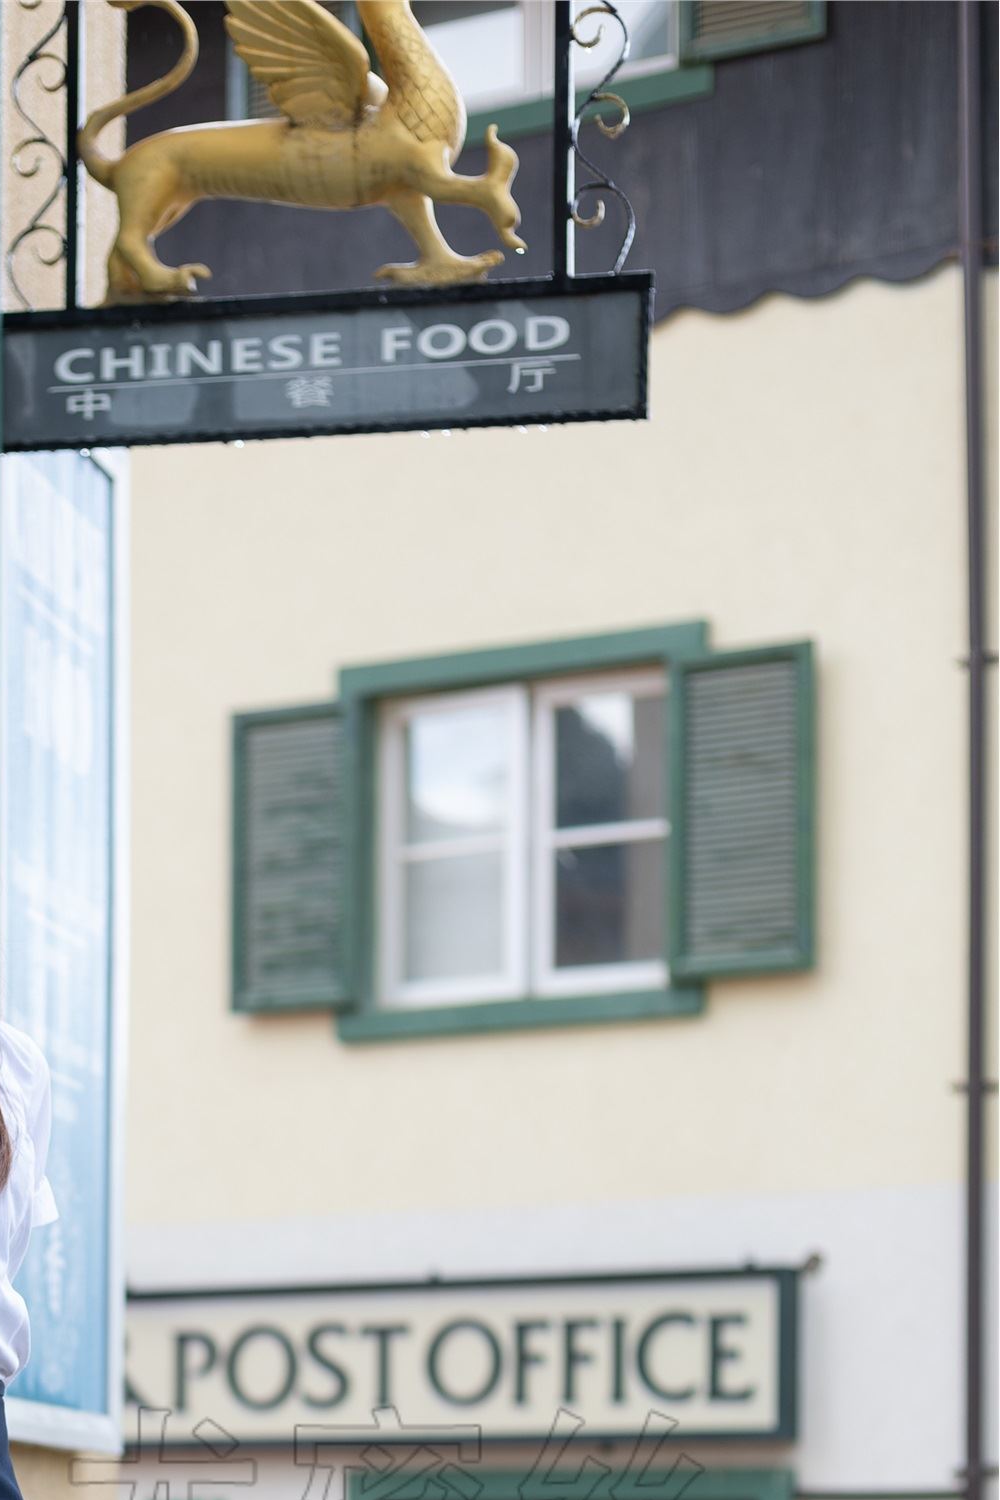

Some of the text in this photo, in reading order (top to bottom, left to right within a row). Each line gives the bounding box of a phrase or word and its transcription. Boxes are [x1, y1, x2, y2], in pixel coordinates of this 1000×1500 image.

[53, 314, 571, 384] CHINESE FOOD
[171, 1320, 411, 1413] POST
[424, 1310, 757, 1408] OFFICE
